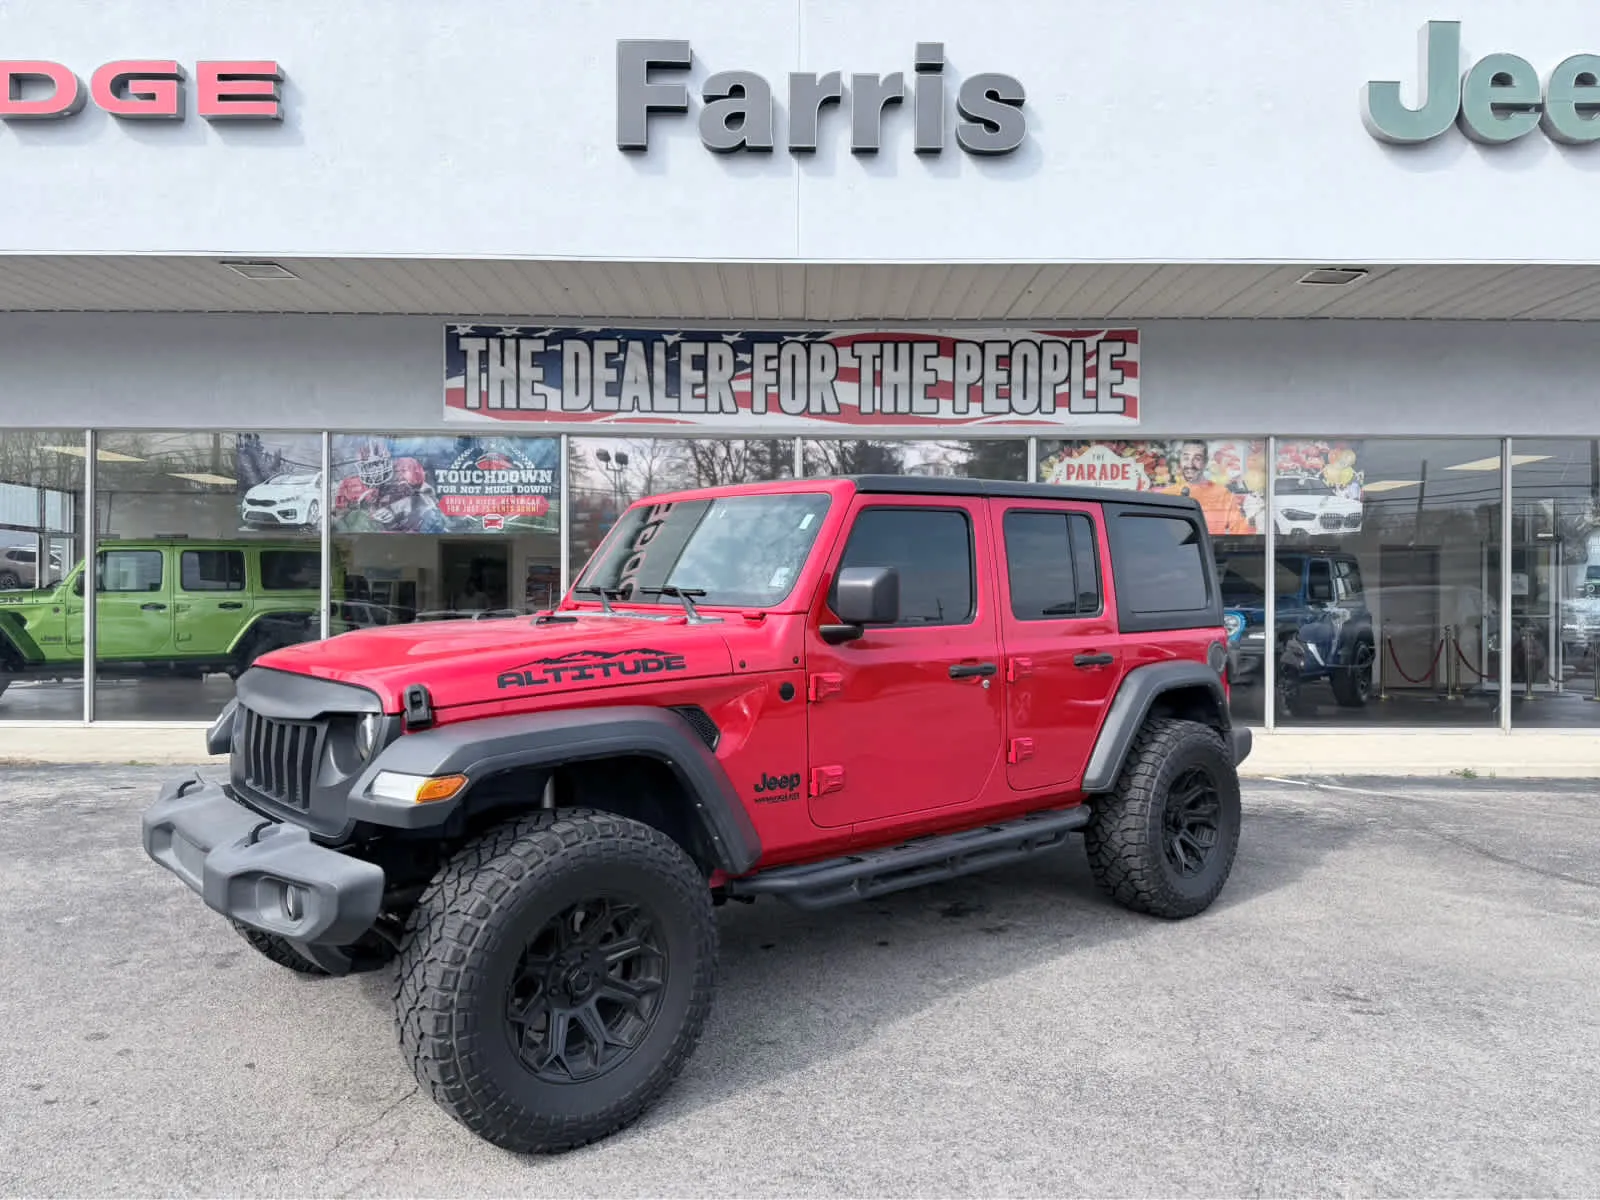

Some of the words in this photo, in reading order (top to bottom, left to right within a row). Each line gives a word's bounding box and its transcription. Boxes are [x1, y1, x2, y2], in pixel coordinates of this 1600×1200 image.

[0, 60, 284, 121] DGE
[616, 39, 1027, 155] Farris
[459, 337, 548, 411] THE
[560, 338, 739, 415] DEALER
[750, 339, 841, 415] FOR
[851, 340, 940, 415] THE
[952, 339, 1127, 415] PEOPLE
[435, 469, 553, 484] TOUCHDOWN
[1066, 463, 1131, 481] PARADE
[437, 485, 457, 494] FOR
[460, 486, 482, 494] NOT
[485, 486, 514, 494] MUCH
[517, 485, 552, 494] DOWN!
[497, 655, 686, 689] ALTITUDE
[754, 772, 800, 792] Jeep
